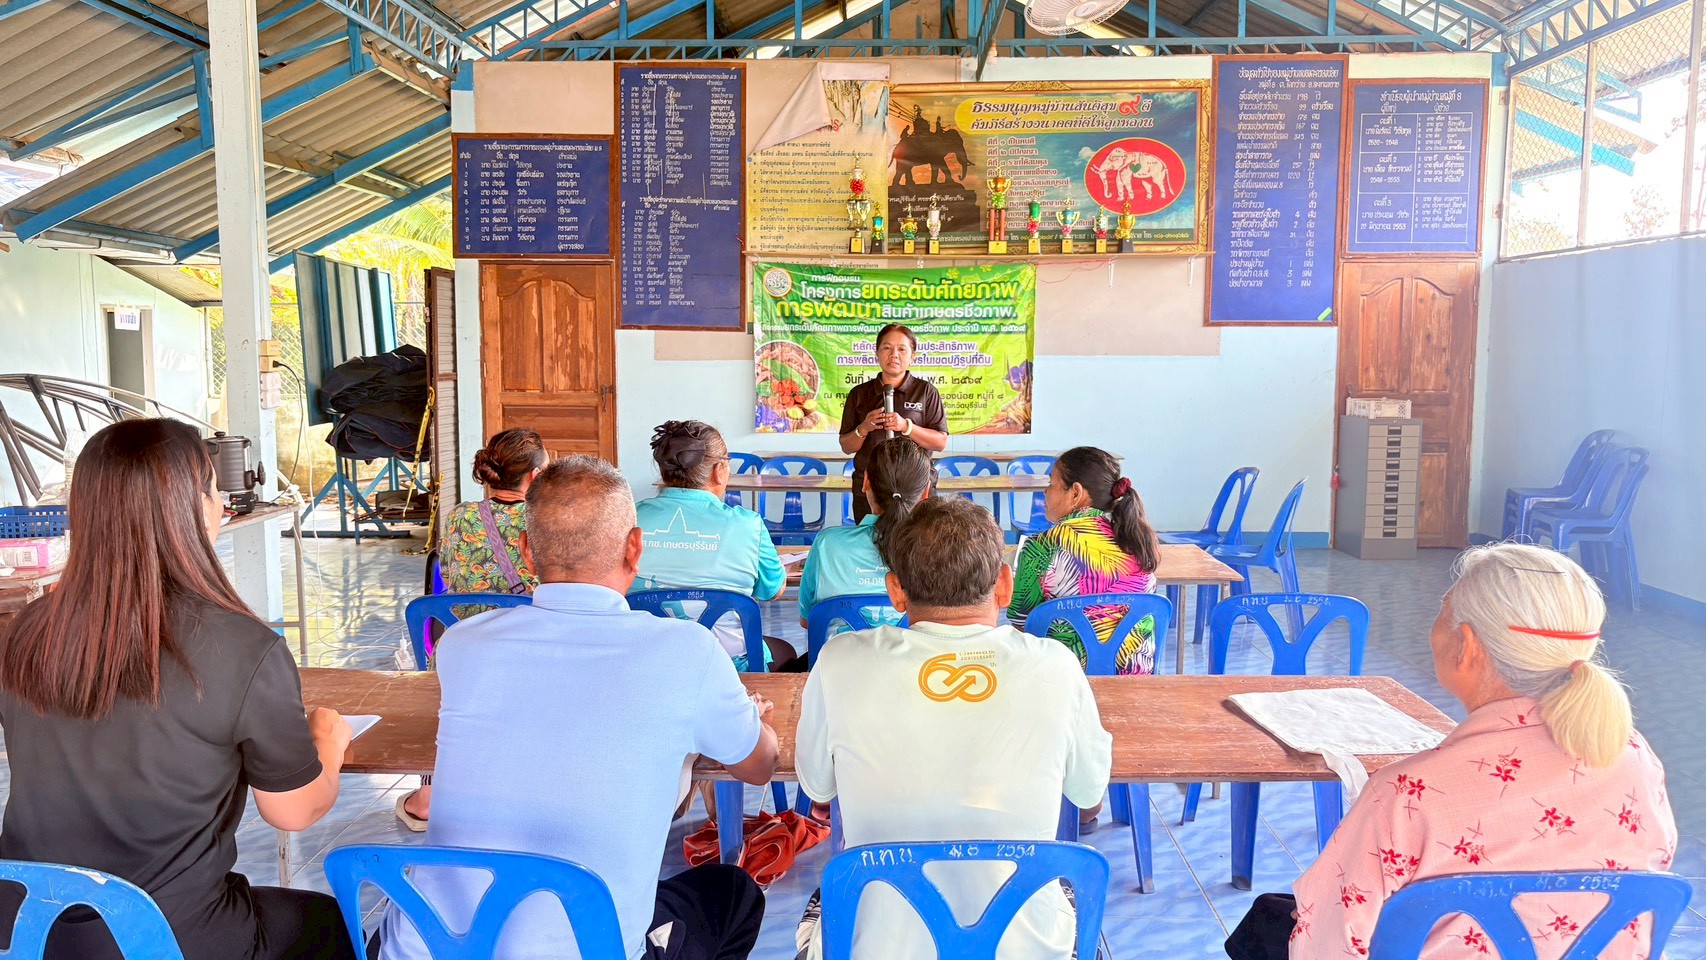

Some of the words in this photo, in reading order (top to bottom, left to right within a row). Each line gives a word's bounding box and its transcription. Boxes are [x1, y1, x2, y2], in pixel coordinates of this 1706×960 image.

[972, 99, 1117, 115] ธรรมนูญหมู่บ้านสันติสุข
[1118, 95, 1141, 117] ๙
[1141, 99, 1151, 113] ดี
[971, 114, 1154, 133] คัมภีร์สร้างอนาคตที่ดีให้ลูกหลาน
[1008, 137, 1035, 146] เป็นคนดี
[1011, 177, 1070, 188] งแวดล้อมสมบูรณ์
[1293, 221, 1298, 229] 2
[1287, 270, 1293, 278] 3
[952, 323, 979, 333] ประจำปี
[982, 324, 998, 332] พ.ศ.
[1001, 324, 1027, 333] ๒๕๖๙
[845, 371, 864, 384] วันที่
[952, 376, 983, 385] ๒๕๖๙
[977, 389, 994, 402] หมู่ที่
[663, 540, 718, 552] เกษตรบุรีรัมย์
